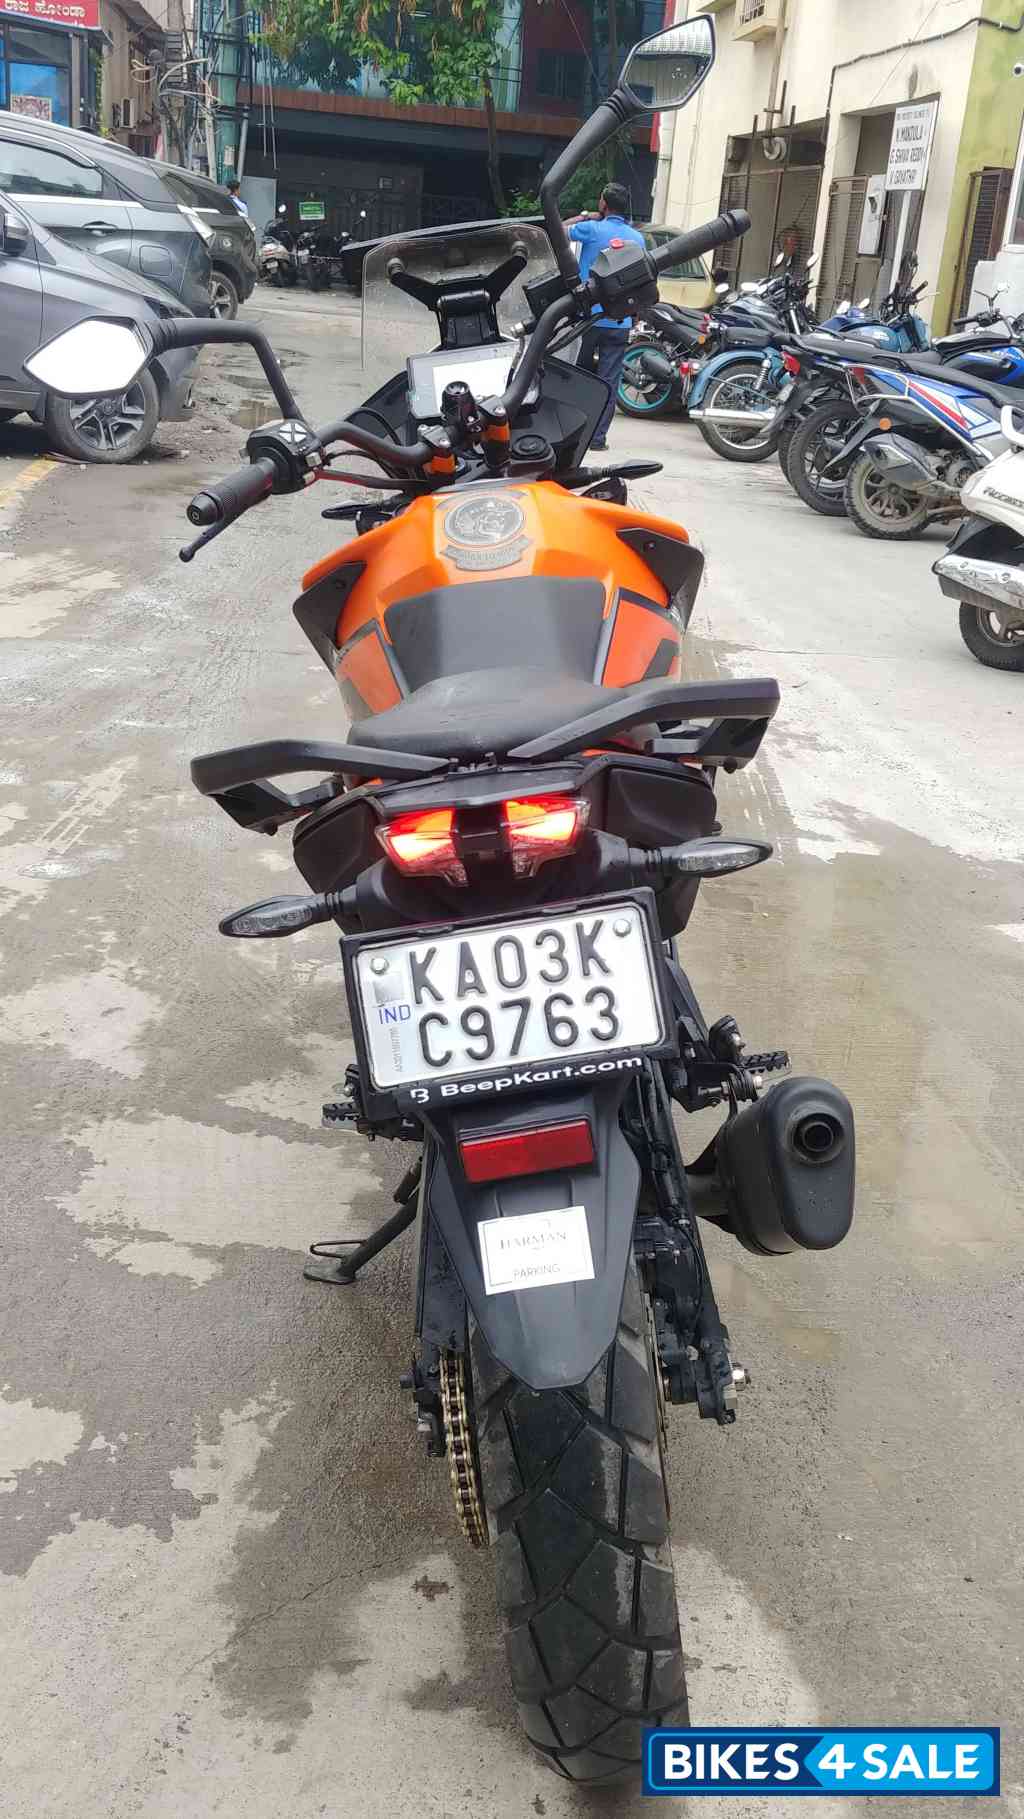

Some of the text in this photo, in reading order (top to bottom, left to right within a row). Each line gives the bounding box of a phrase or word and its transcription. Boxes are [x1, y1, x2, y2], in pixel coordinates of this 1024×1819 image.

[409, 919, 611, 1005] KA03K
[379, 1004, 411, 1024] IND
[418, 985, 620, 1067] C9763
[440, 1056, 643, 1098] BeepKart.com
